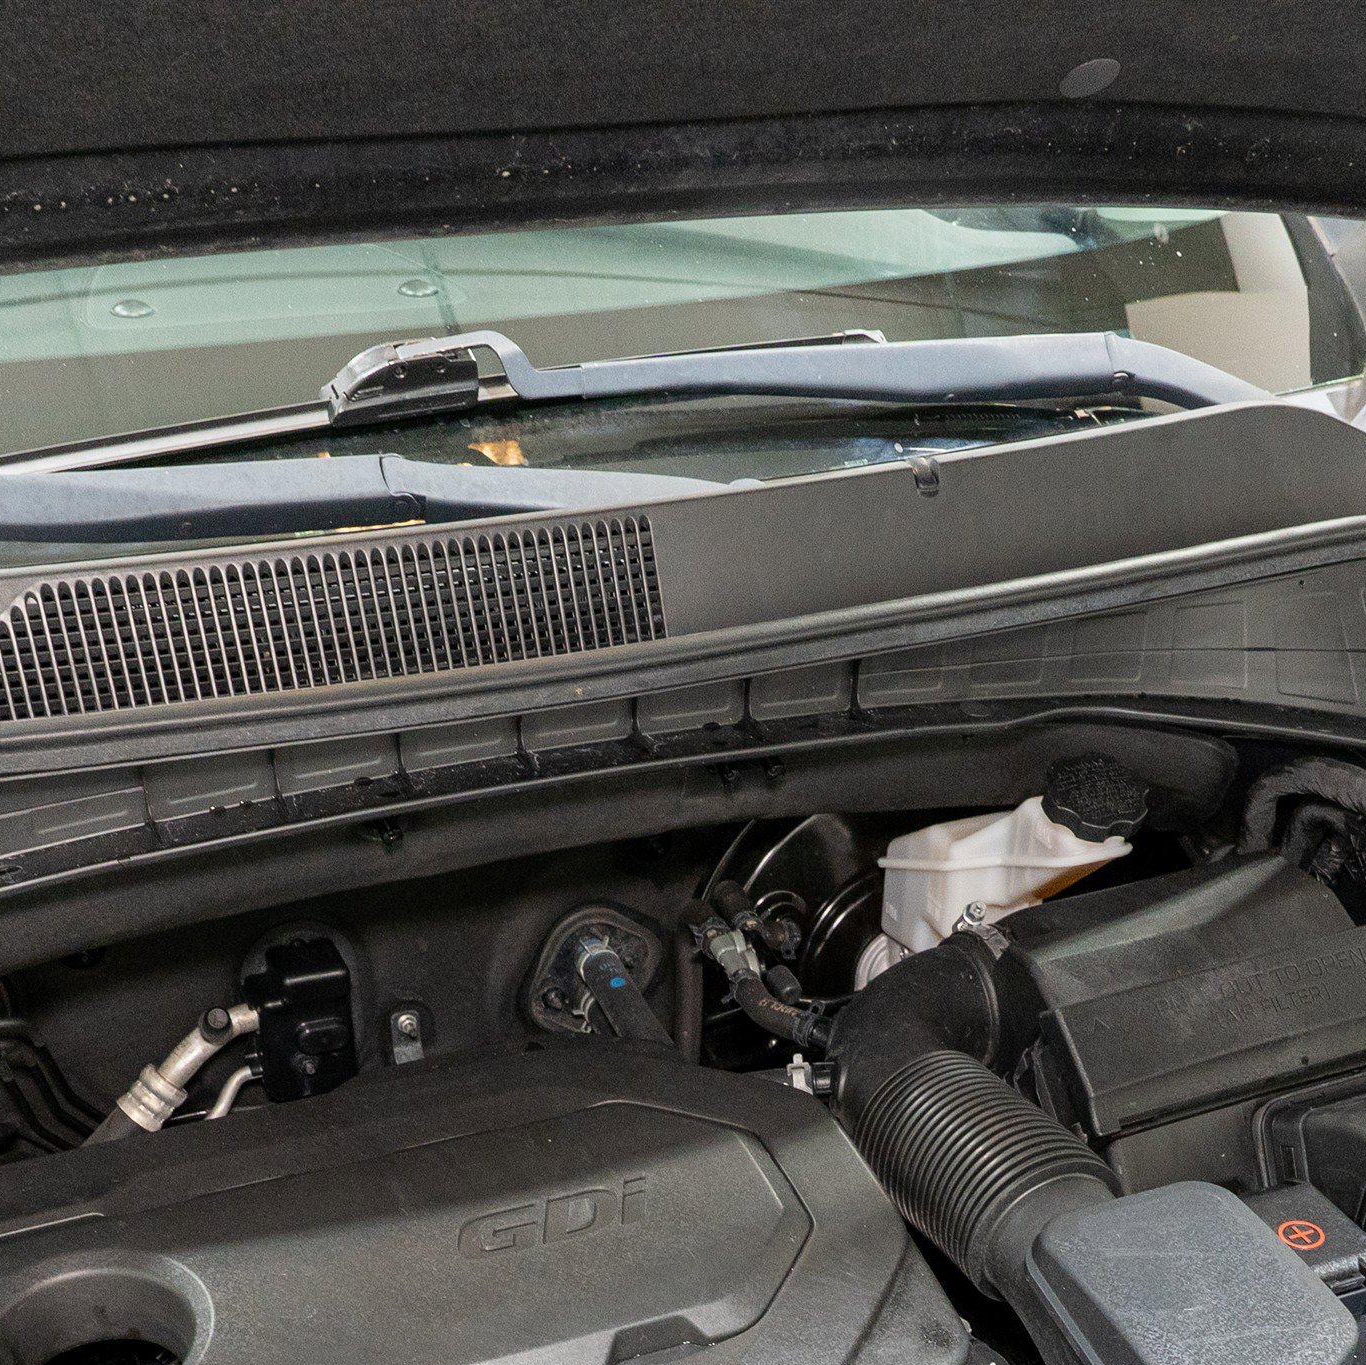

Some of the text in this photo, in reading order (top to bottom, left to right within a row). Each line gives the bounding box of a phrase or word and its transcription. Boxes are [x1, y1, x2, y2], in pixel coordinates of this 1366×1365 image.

[1220, 971, 1264, 1001] OUT
[1269, 963, 1303, 987] TO
[1260, 982, 1333, 1015] FILTER)
